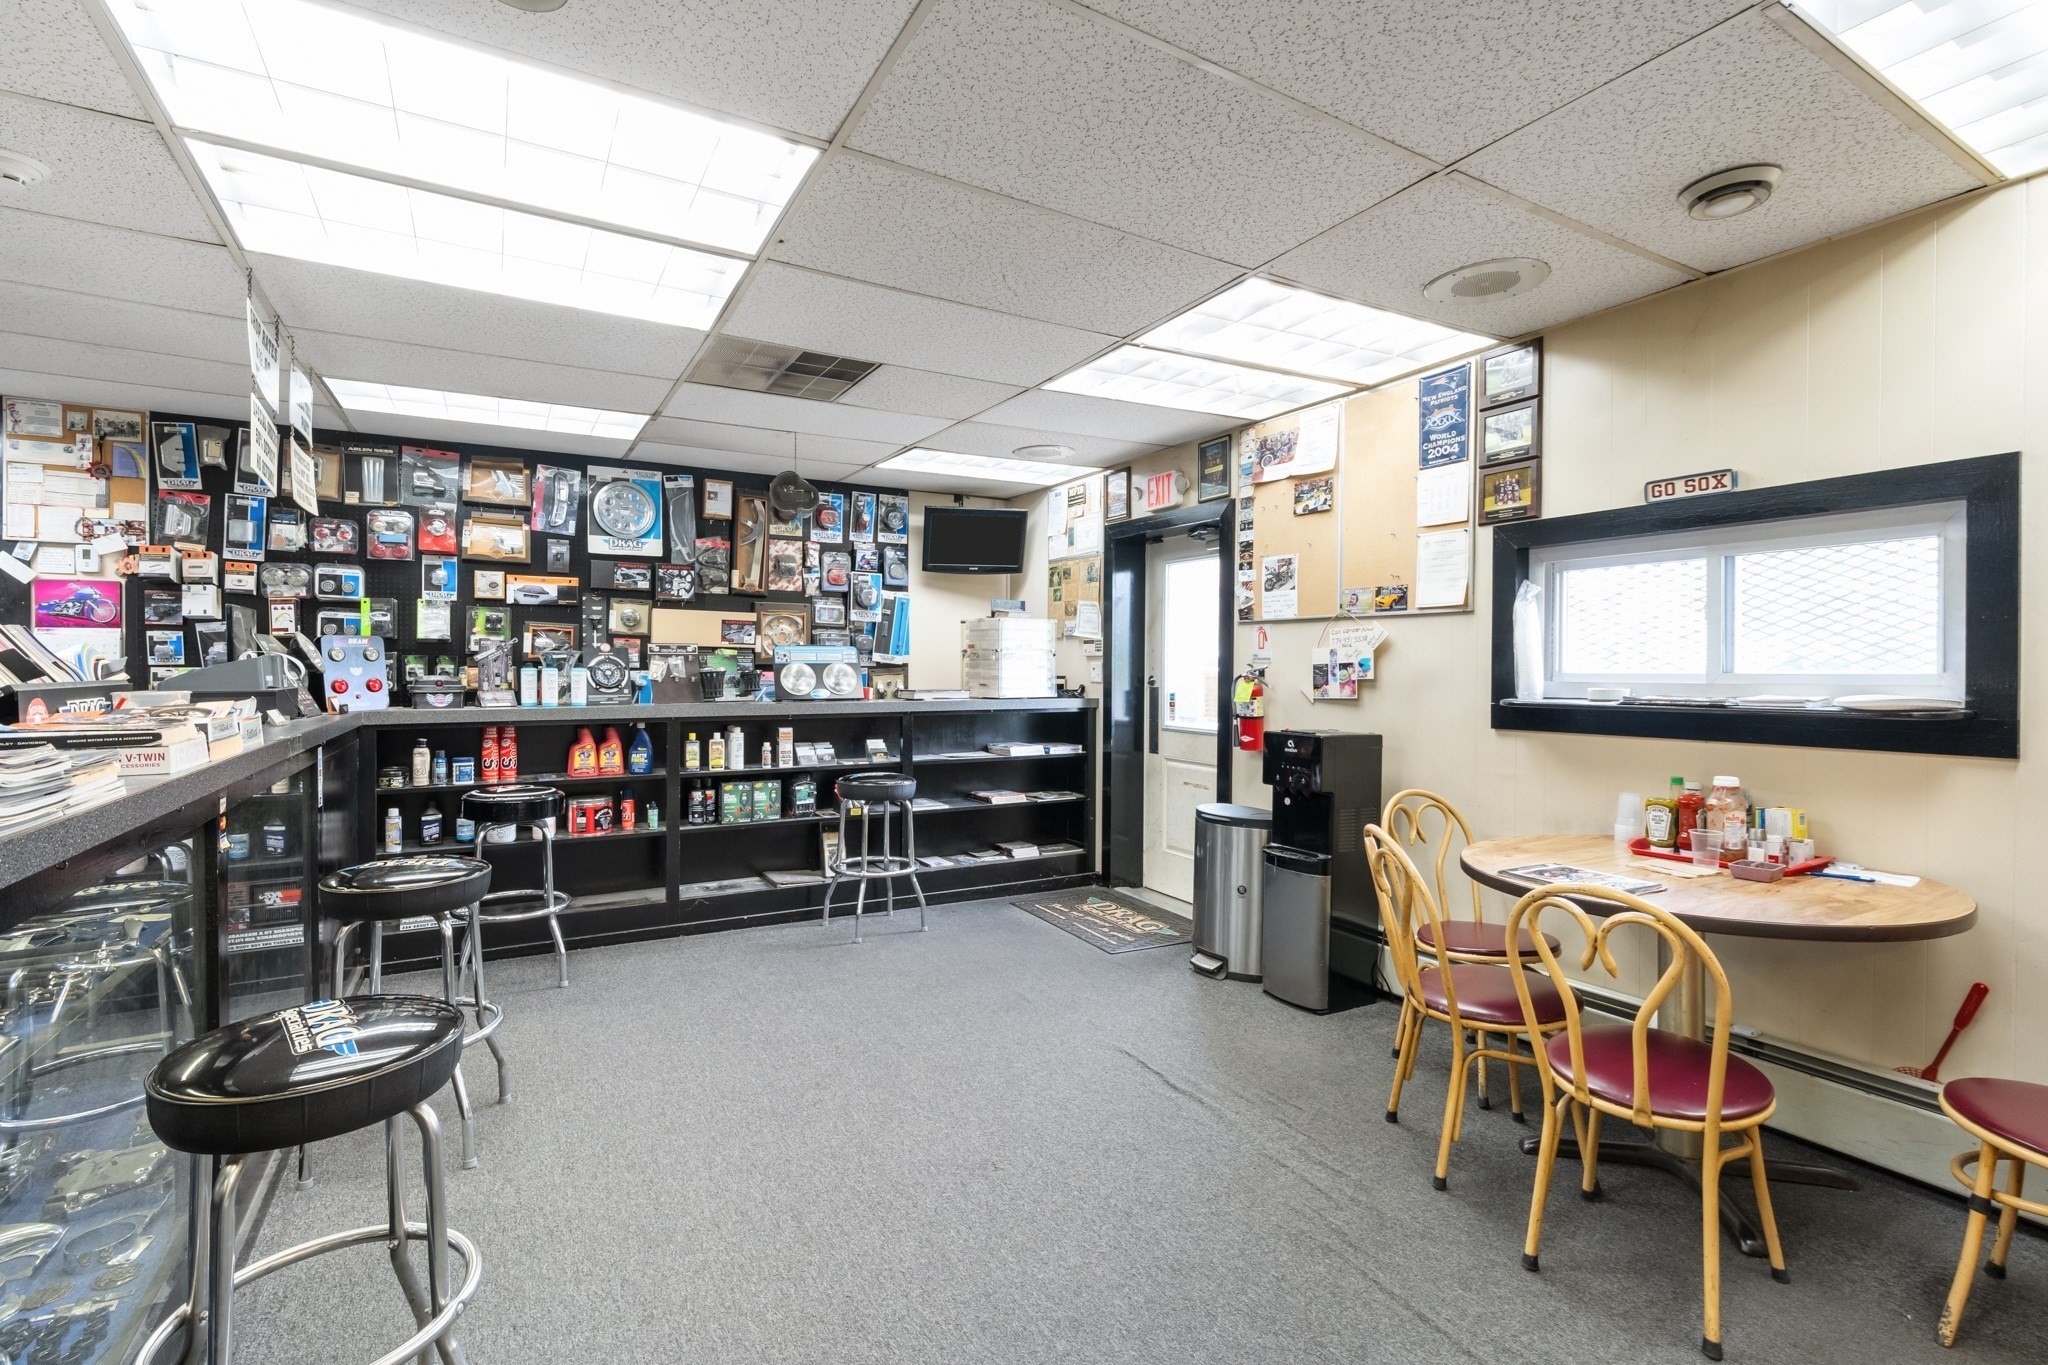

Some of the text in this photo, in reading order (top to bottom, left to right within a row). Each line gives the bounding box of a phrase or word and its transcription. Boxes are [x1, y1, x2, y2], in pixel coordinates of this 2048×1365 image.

[262, 329, 278, 363] RATES
[1422, 385, 1467, 403] NEW ENGLAND
[1430, 394, 1458, 406] PATRIOTS
[1424, 411, 1465, 431] XXXIX
[1423, 435, 1466, 450] CHAMPIONS
[1429, 431, 1457, 441] WORLD
[1427, 444, 1460, 459] 2004
[243, 484, 268, 493] DRAG
[1147, 472, 1173, 509] EXIT
[1651, 473, 1728, 498] GO SOX
[609, 538, 643, 547] DRAG
[125, 752, 165, 762] V-TWIN
[1091, 901, 1162, 932] DRAG
[300, 1000, 359, 1048] DRAG
